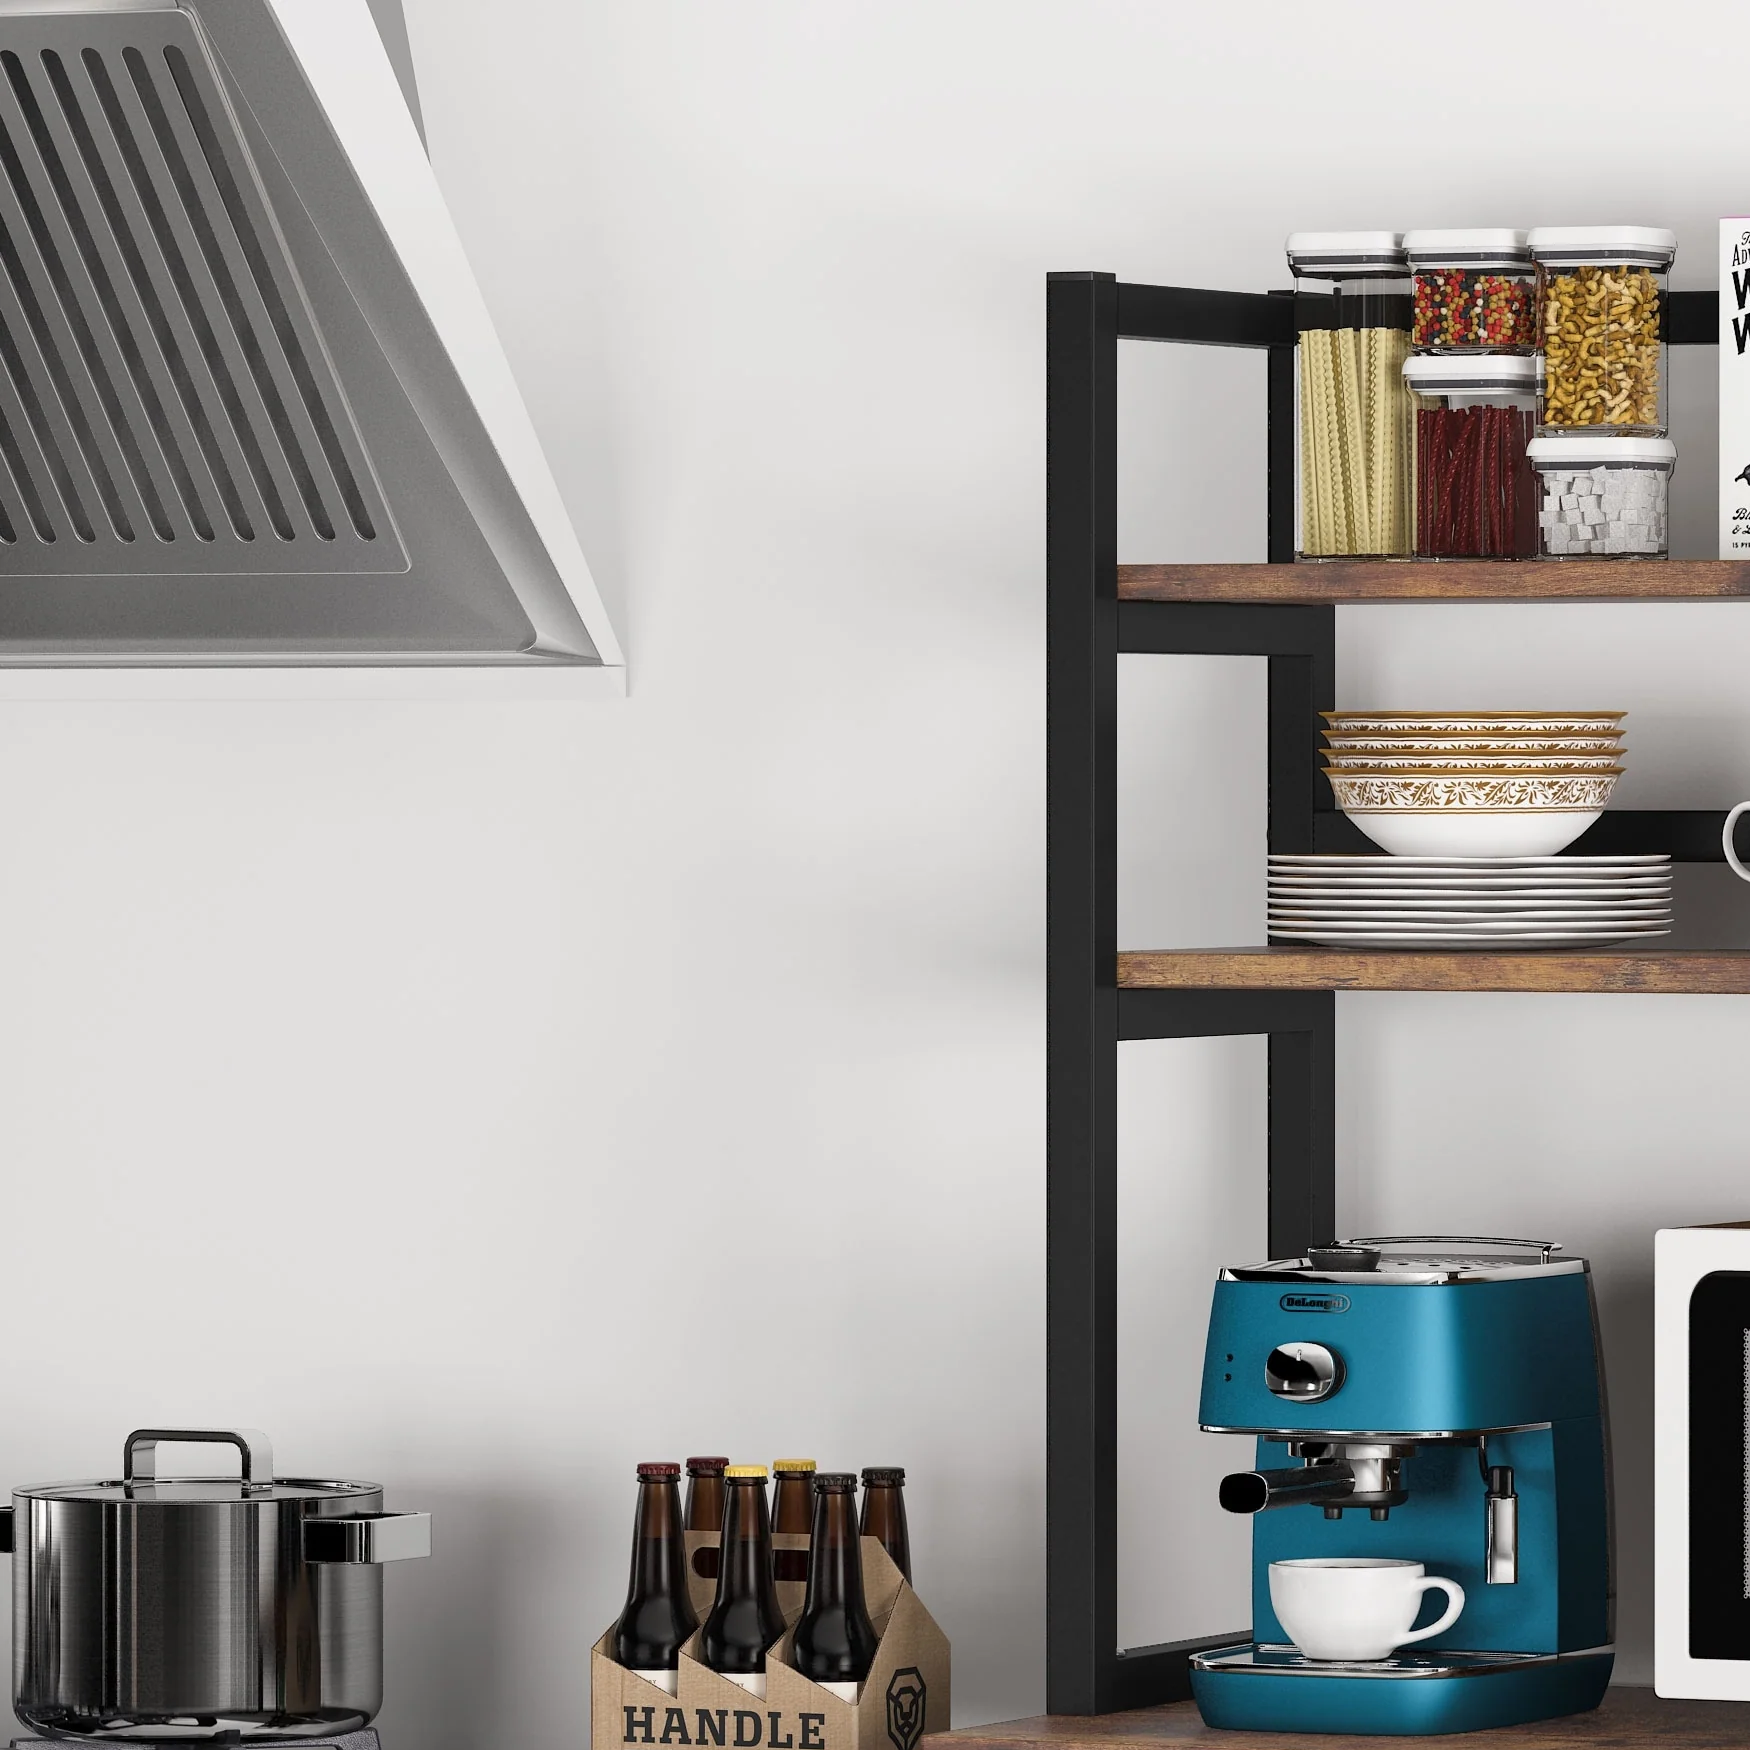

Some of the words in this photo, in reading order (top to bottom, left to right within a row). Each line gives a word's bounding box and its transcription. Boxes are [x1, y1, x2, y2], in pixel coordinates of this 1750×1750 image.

[1732, 525, 1740, 534] &
[1286, 1297, 1343, 1309] DeLonghi
[623, 1705, 826, 1750] HANDLE
